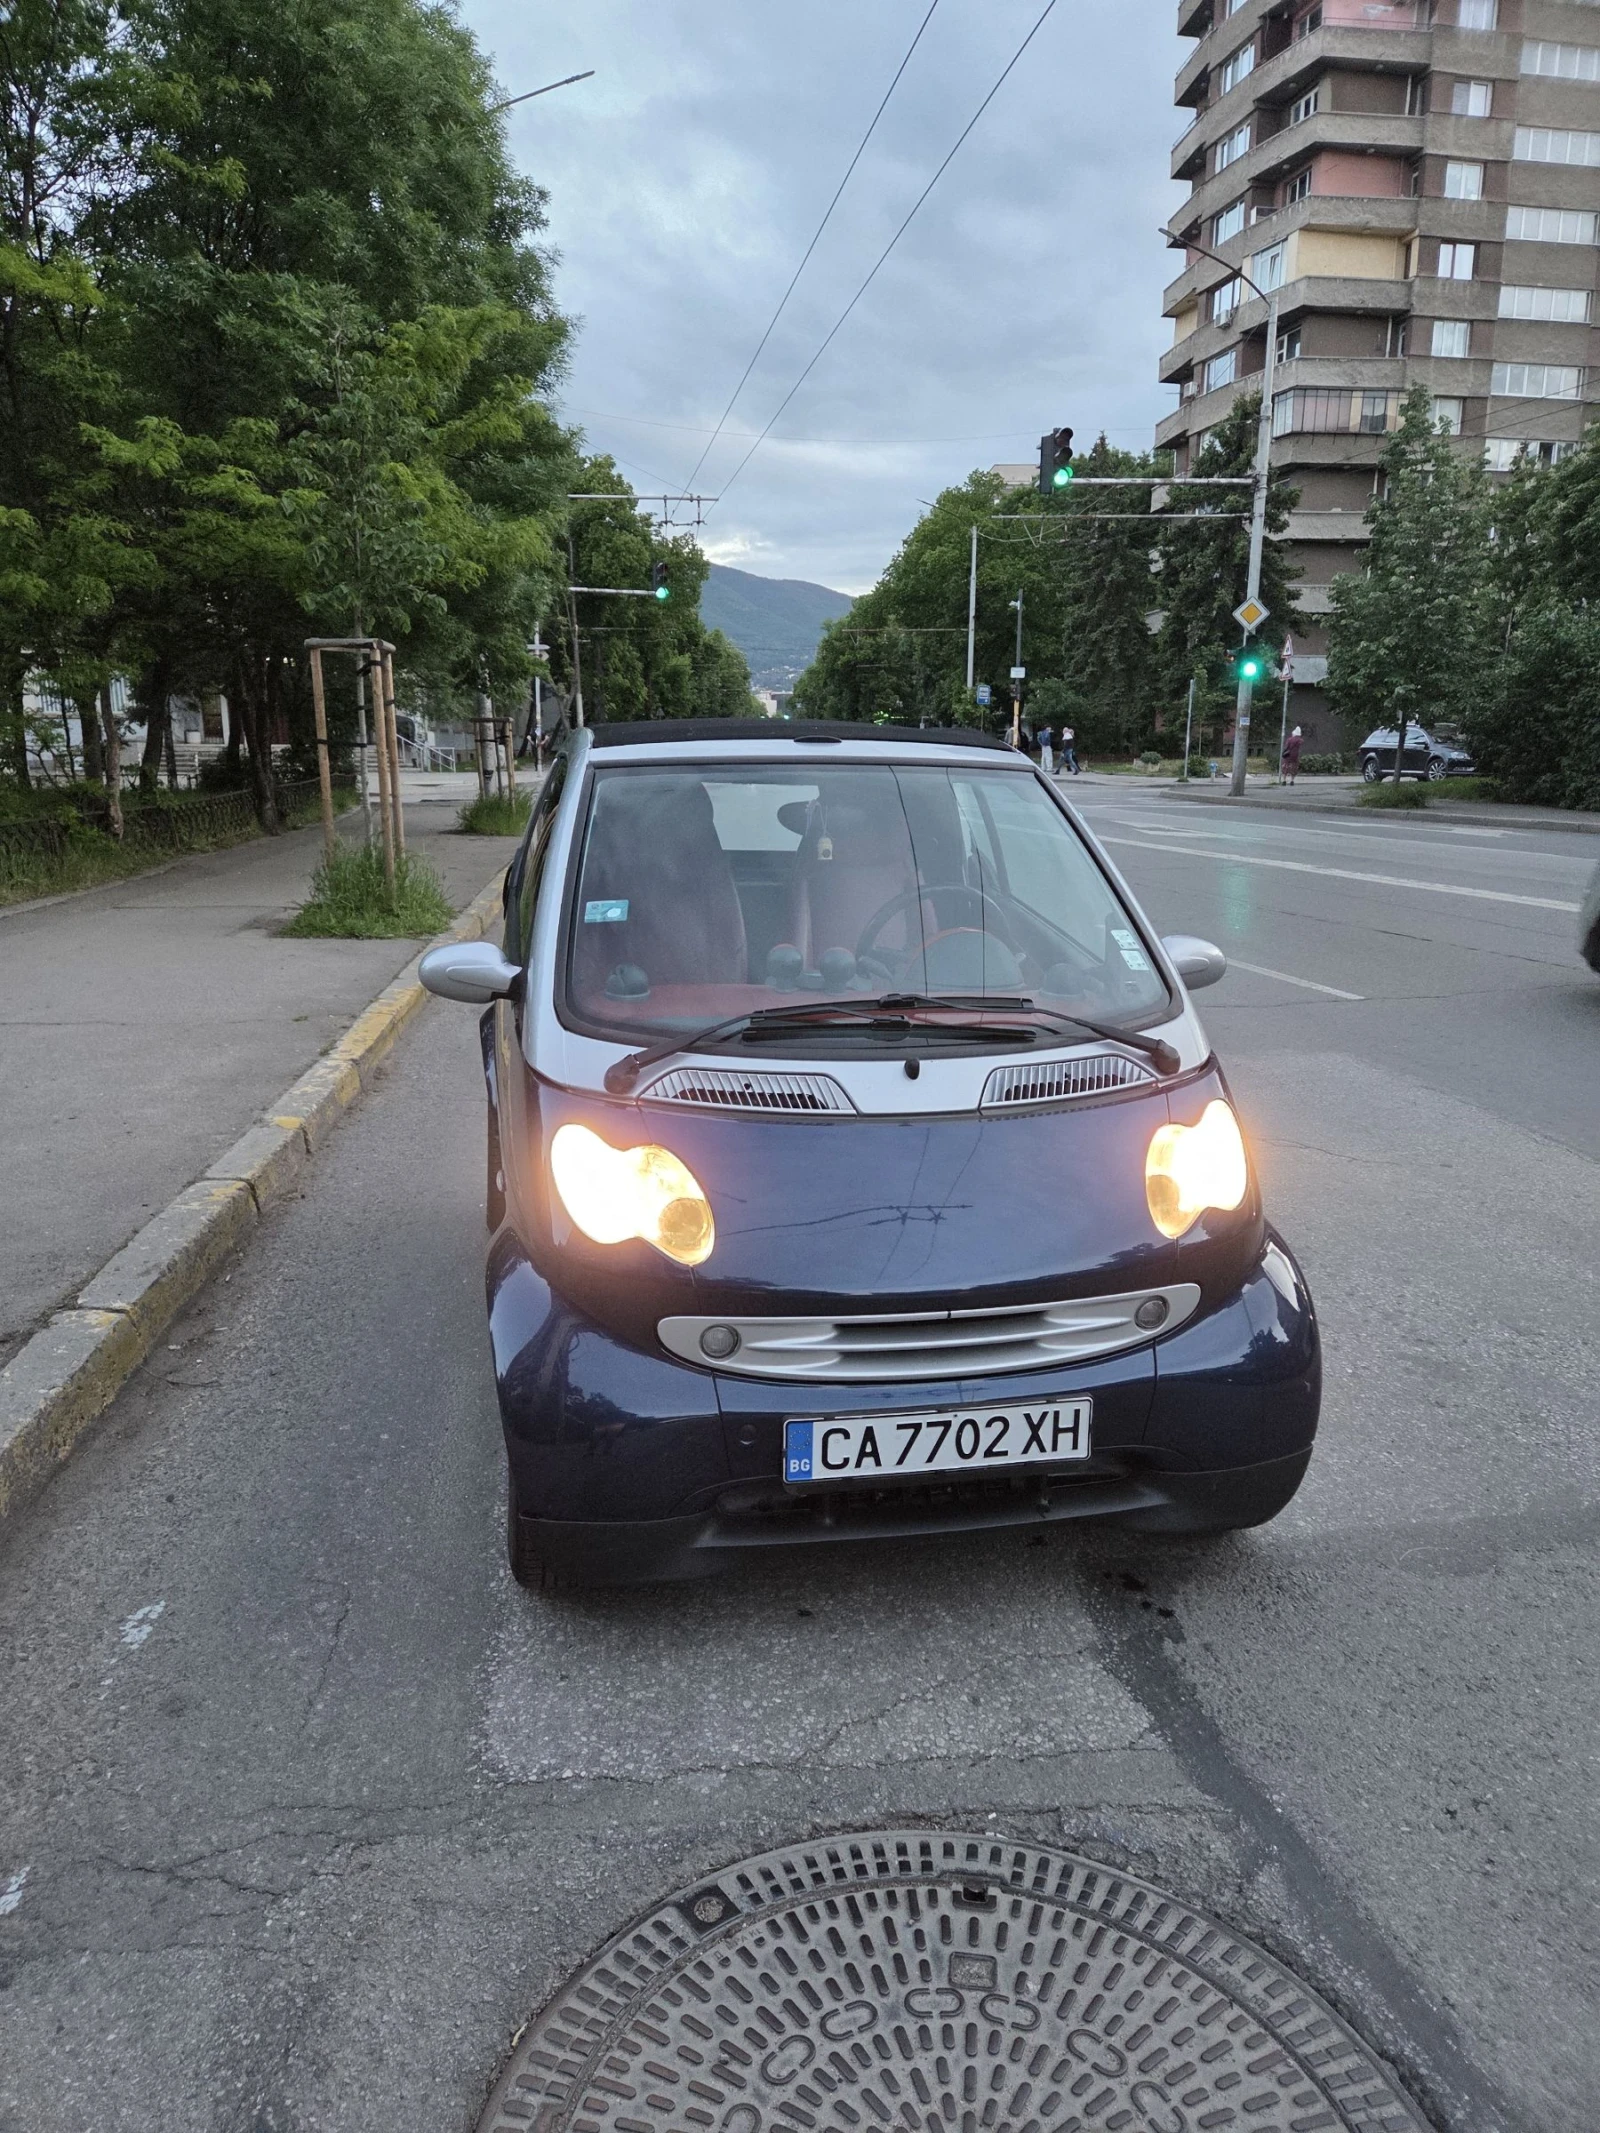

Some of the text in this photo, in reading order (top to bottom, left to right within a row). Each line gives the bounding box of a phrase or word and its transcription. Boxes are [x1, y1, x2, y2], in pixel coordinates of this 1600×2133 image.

[821, 1408, 1081, 1470] CA 7702 XH
[789, 1459, 811, 1473] BG
